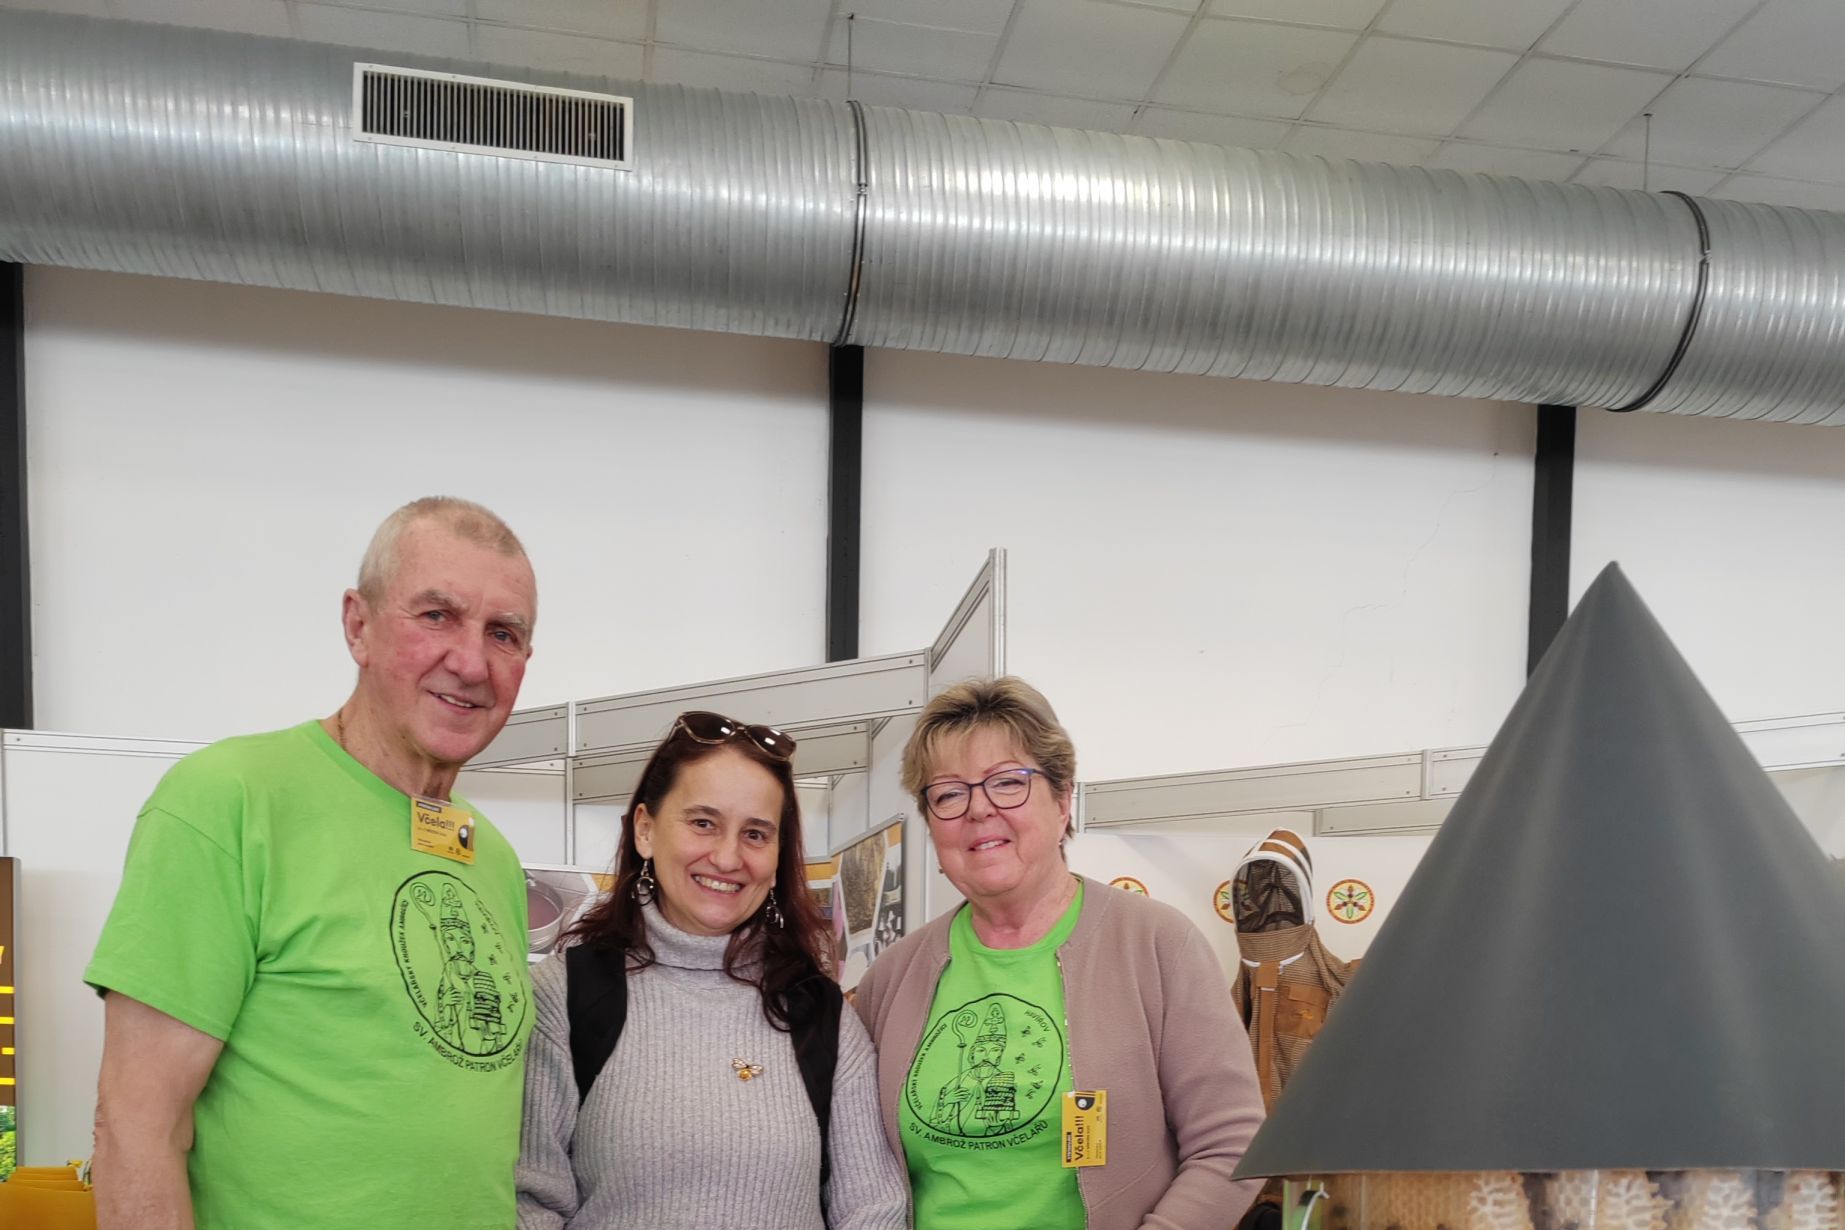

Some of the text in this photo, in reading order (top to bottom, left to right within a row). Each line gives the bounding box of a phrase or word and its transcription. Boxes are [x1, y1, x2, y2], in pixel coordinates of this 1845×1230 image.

[908, 1120, 1049, 1151] SV. AMBROŽ PATRON VČELAŘŮ
[1074, 1116, 1085, 1161] Včela!!!
